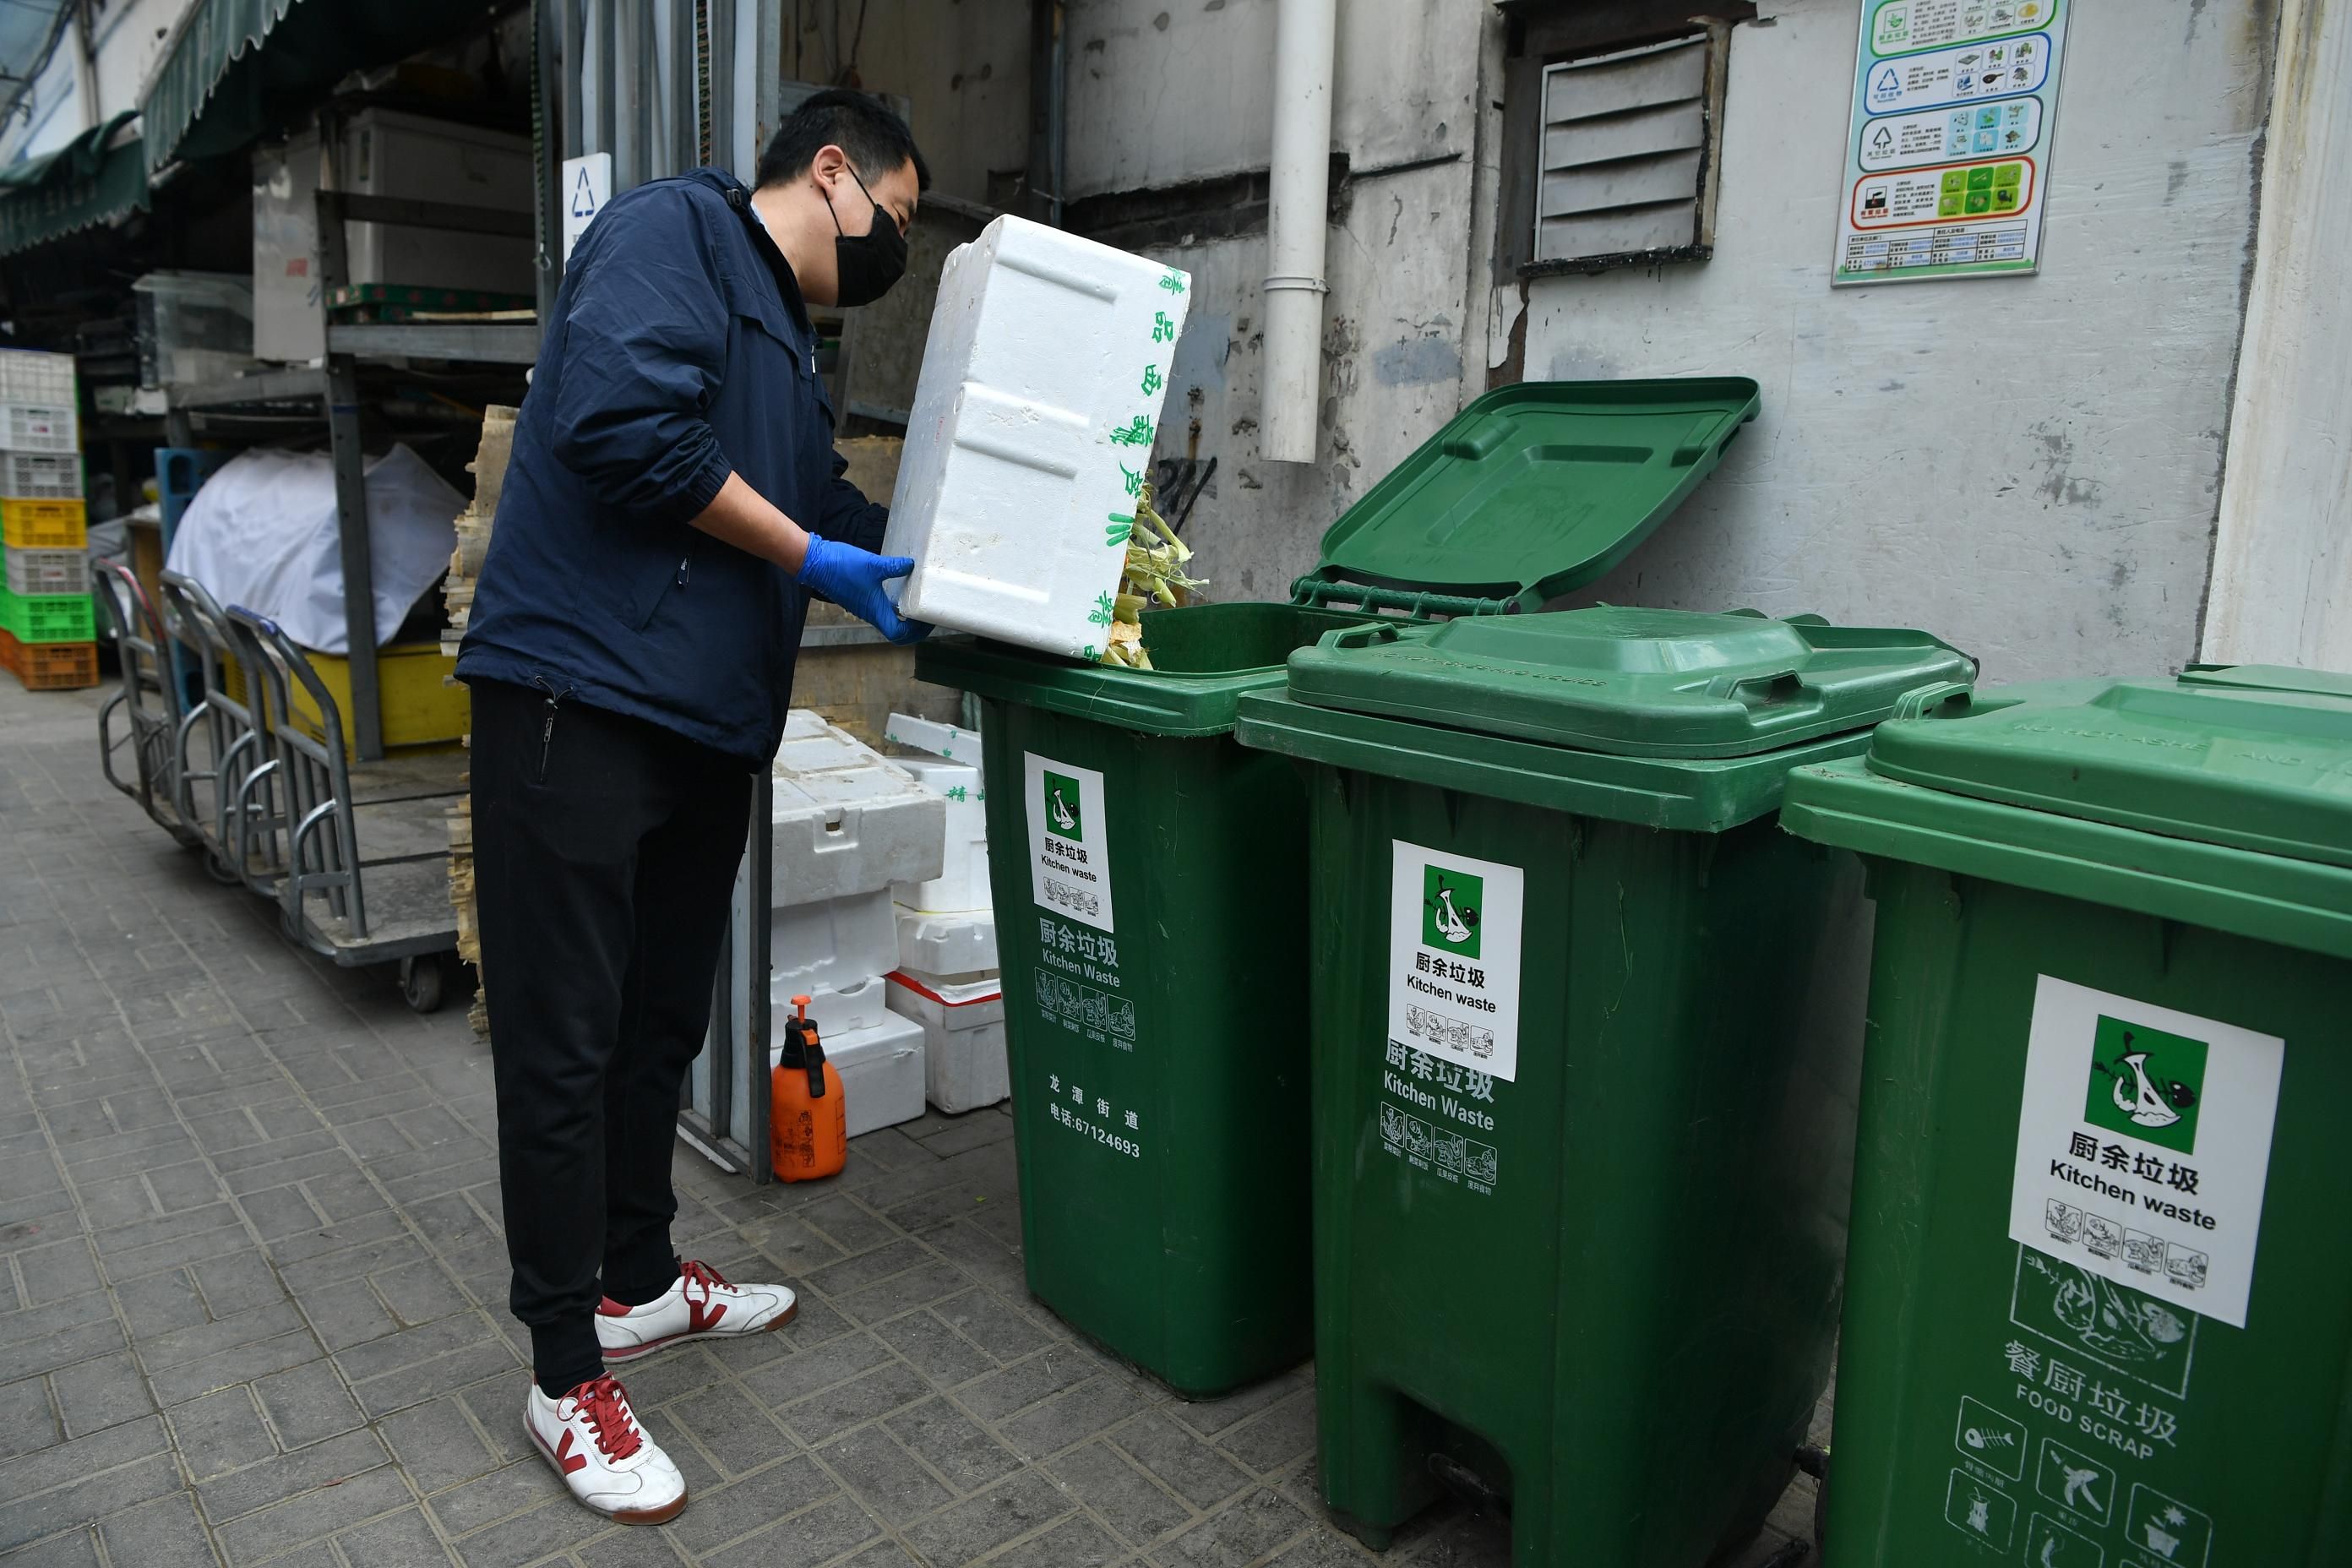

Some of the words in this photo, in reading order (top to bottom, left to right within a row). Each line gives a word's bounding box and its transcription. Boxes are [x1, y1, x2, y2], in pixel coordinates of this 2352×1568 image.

[1041, 854, 1070, 874] Kitchen
[1072, 867, 1097, 883] waste
[1044, 837, 1088, 864] 厨余垃圾
[1039, 917, 1119, 968] 厨余垃圾
[1043, 948, 1081, 975] Kitchen
[1083, 962, 1121, 988] Waste
[1416, 951, 1485, 989] 厨余垃圾
[1407, 973, 1452, 1001] Kitchen
[1456, 993, 1496, 1013] waste
[1385, 1037, 1494, 1103] 厨余垃圾
[1384, 1070, 1436, 1111] Kitchen
[1440, 1094, 1494, 1131] Waste
[2069, 1130, 2199, 1196] 厨余垃圾
[2050, 1159, 2136, 1206] Kitchen
[2143, 1194, 2217, 1231] waste
[2004, 1338, 2178, 1448] 餐厨垃圾
[2016, 1384, 2073, 1424] FOOD
[2078, 1415, 2154, 1461] SCRAP
